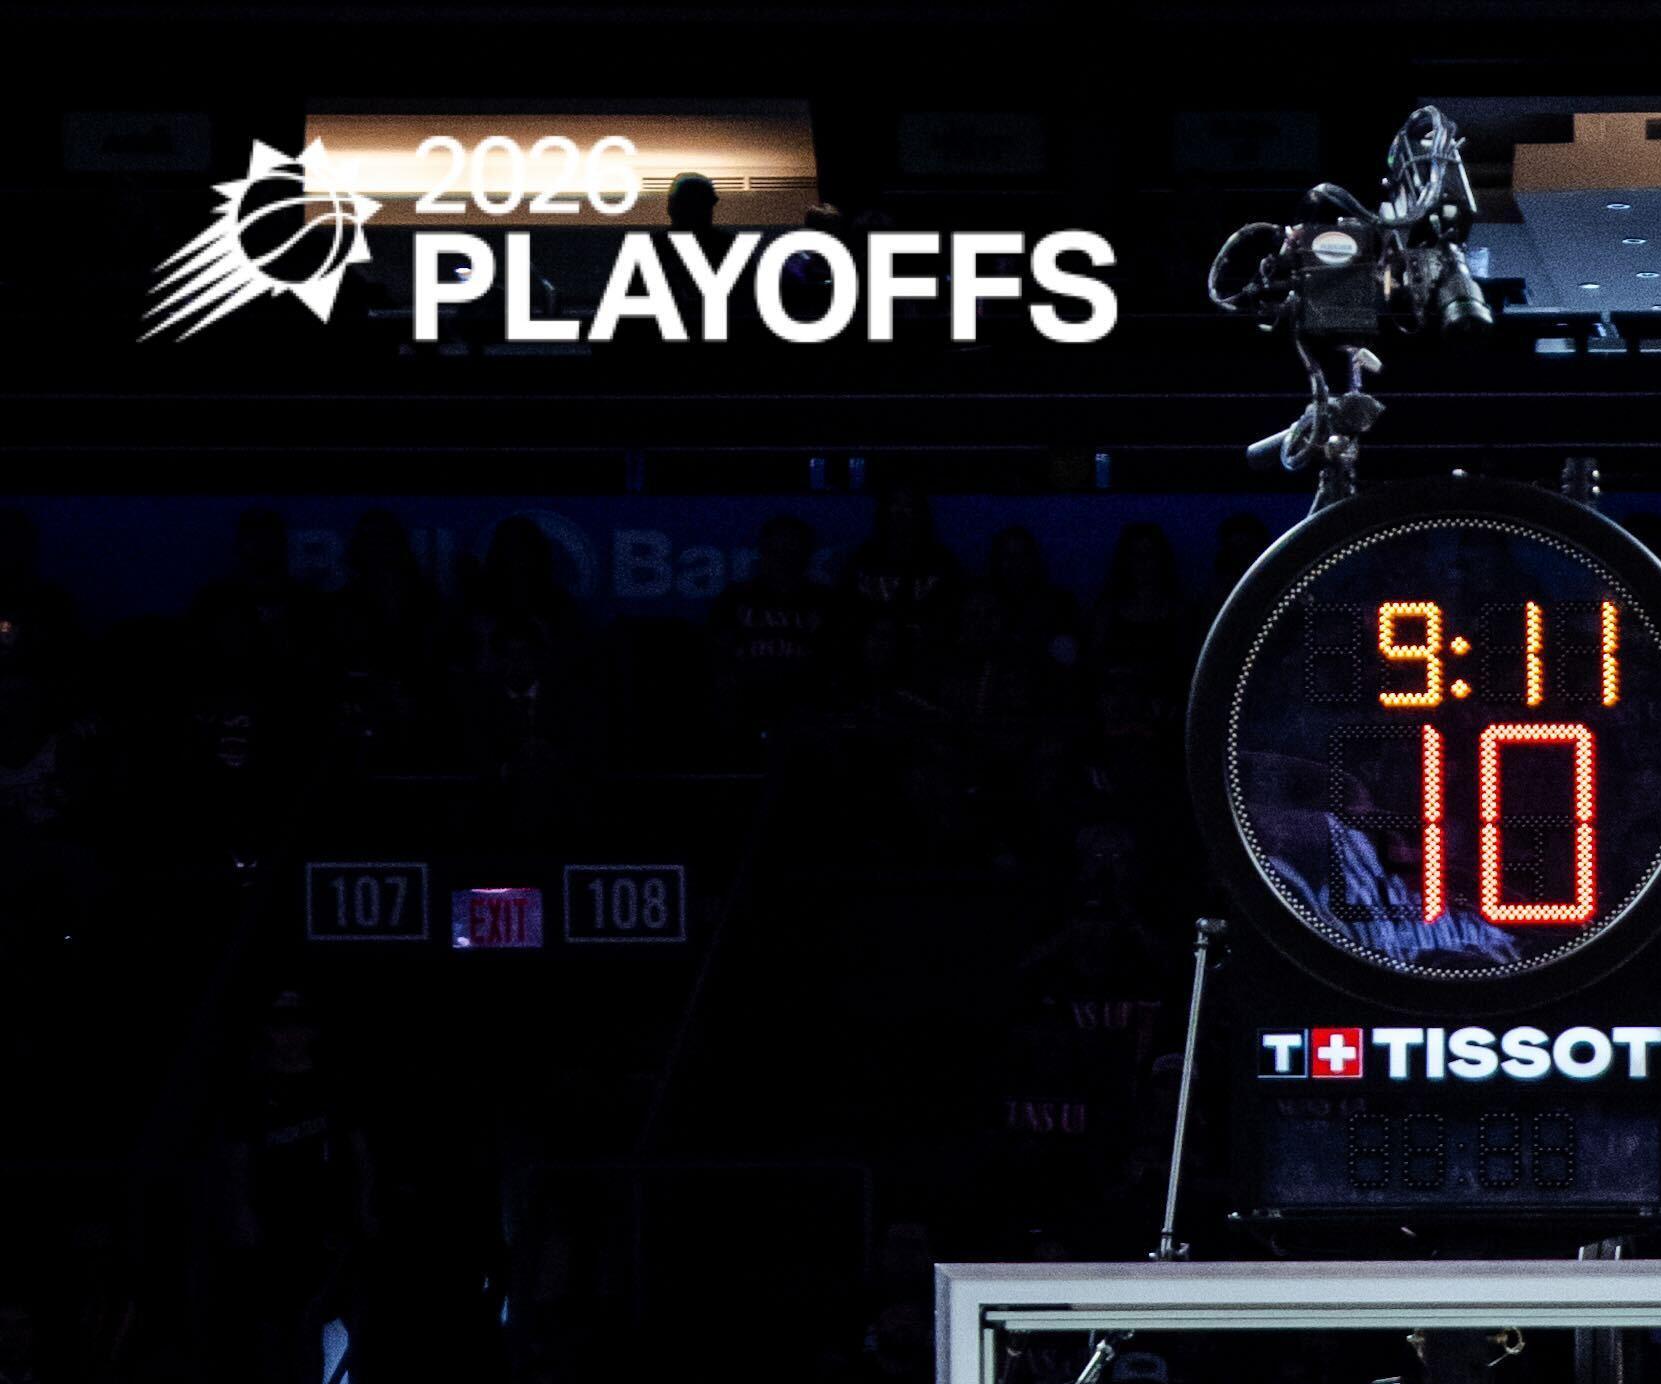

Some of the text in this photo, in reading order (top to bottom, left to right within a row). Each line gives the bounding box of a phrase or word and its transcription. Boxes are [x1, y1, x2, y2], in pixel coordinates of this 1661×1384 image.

[1377, 600, 1622, 708] 9:11
[1419, 722, 1599, 924] 10
[329, 875, 410, 929] 107
[469, 898, 528, 945] EXIT
[586, 877, 668, 929] 108
